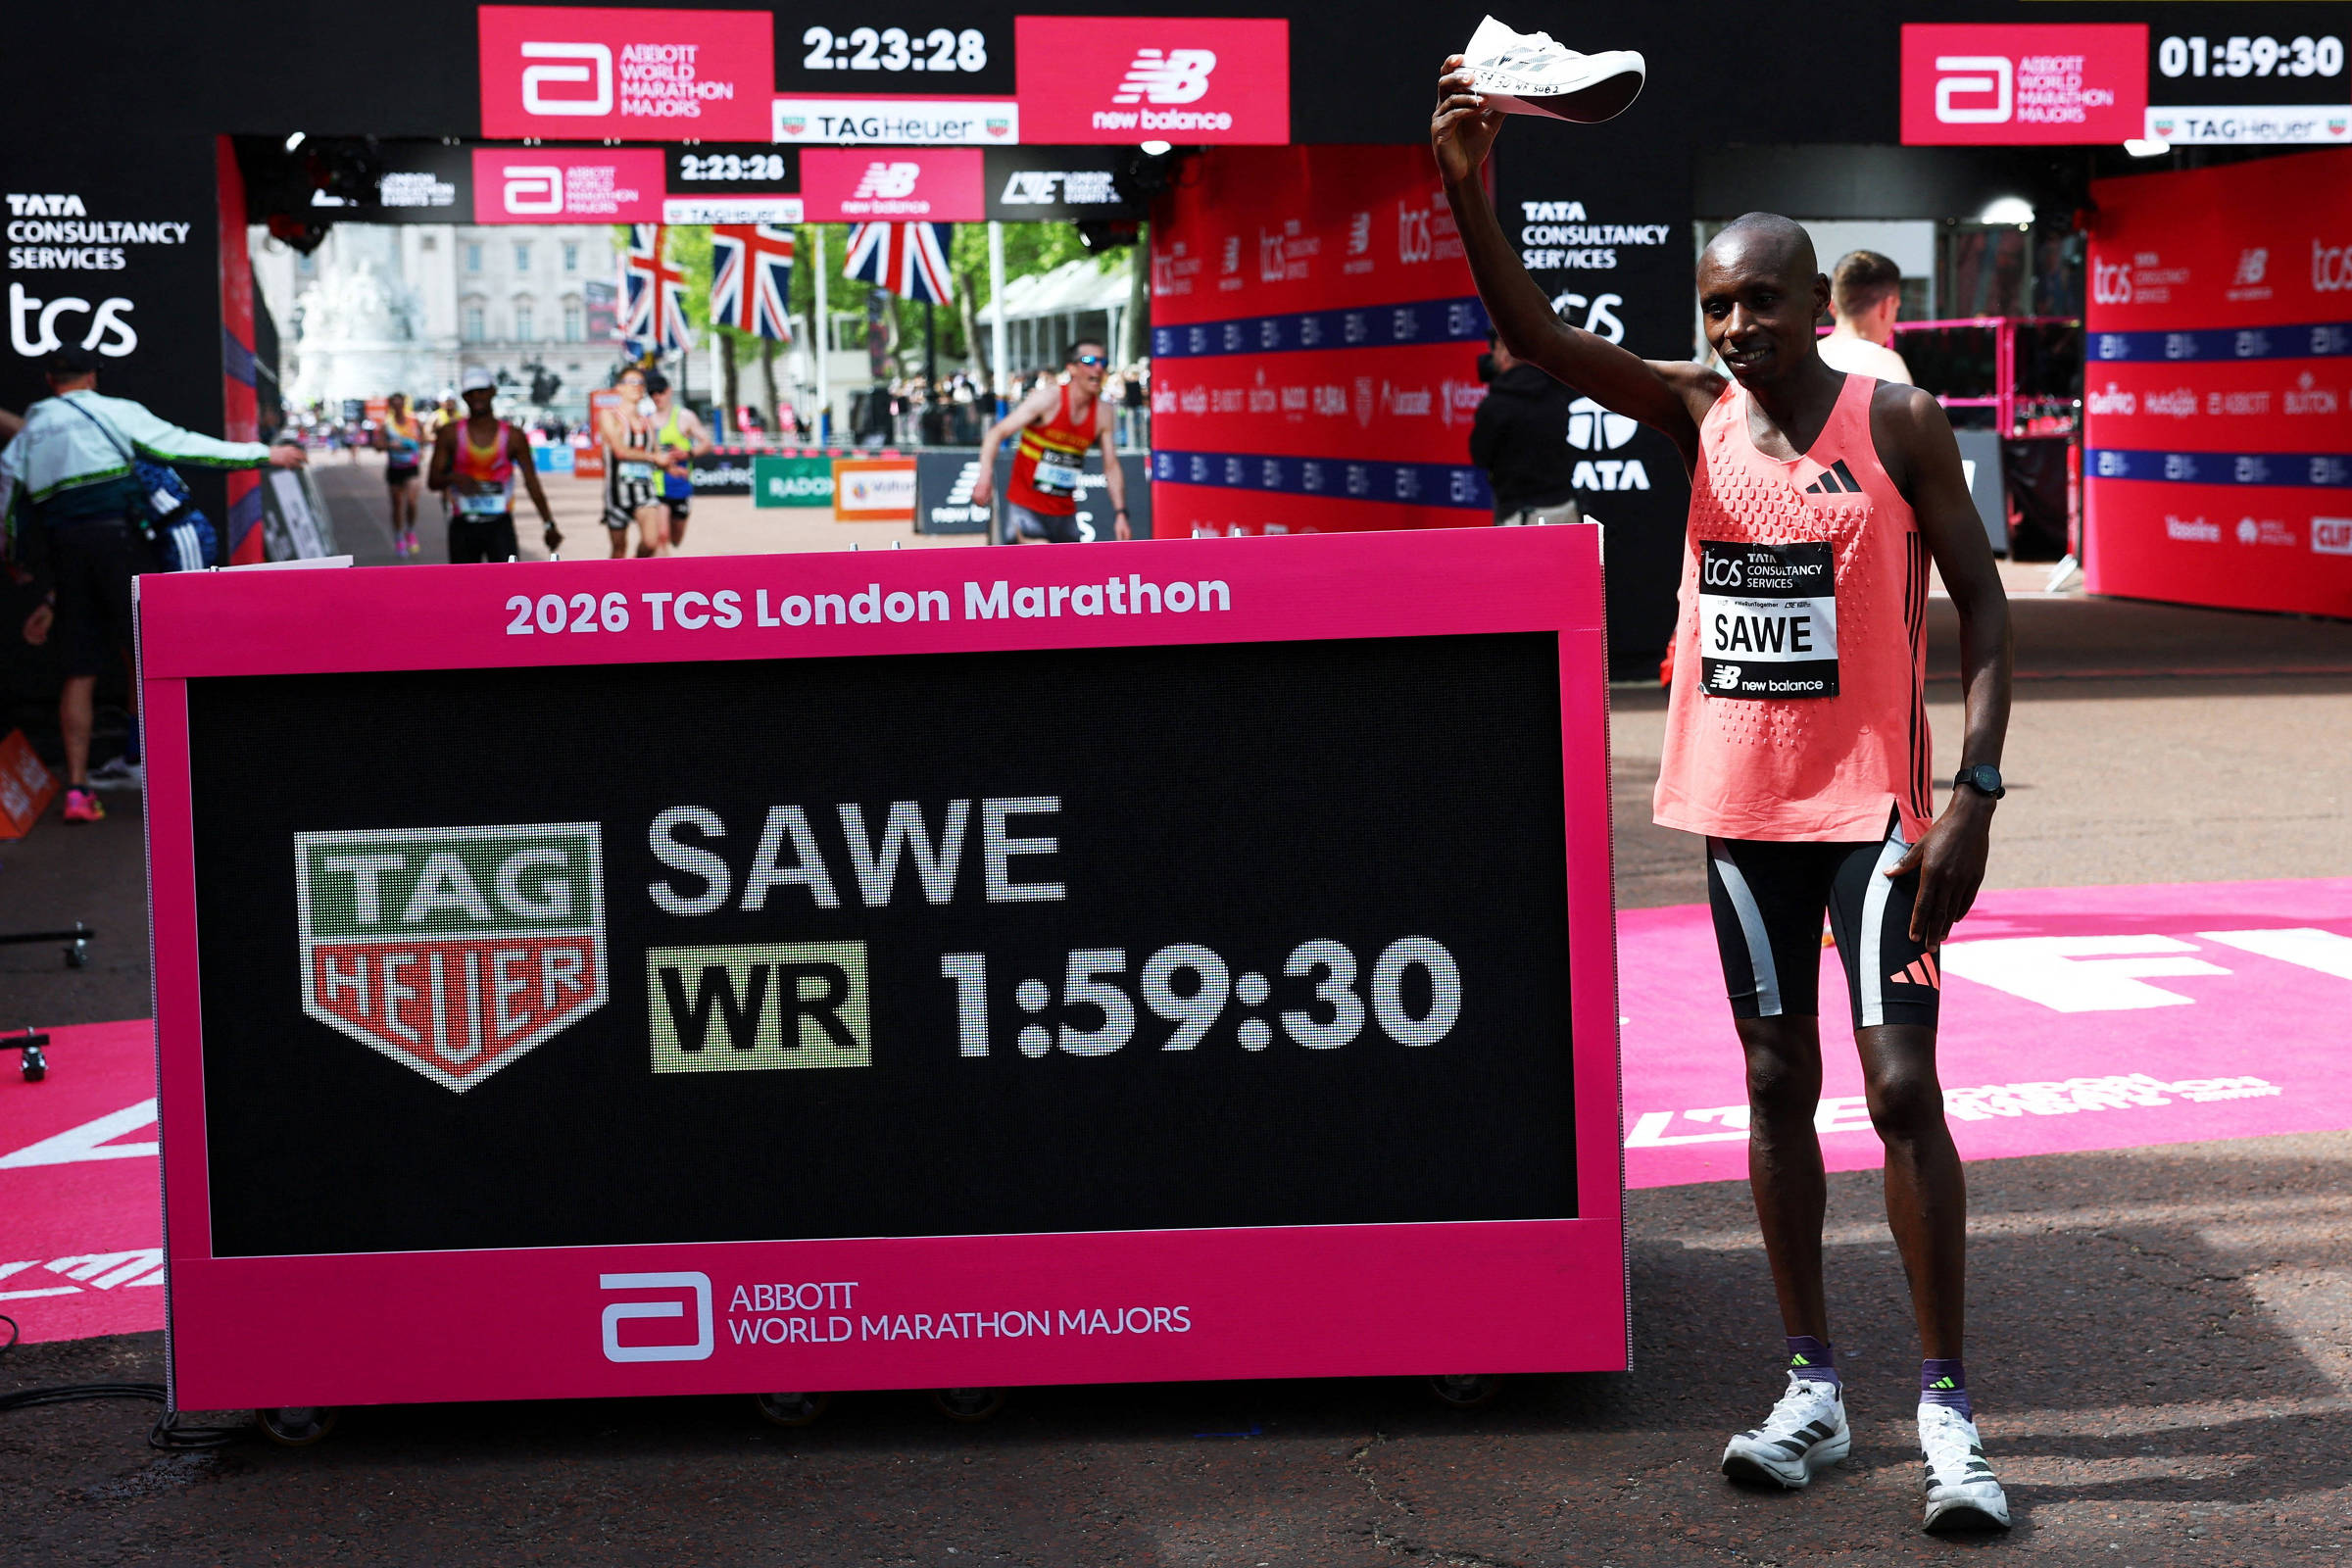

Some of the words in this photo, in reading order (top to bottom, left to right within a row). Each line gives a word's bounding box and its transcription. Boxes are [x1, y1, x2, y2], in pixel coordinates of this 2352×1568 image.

[619, 43, 699, 64] ABBOTT
[803, 26, 987, 73] 2:23:28
[2159, 35, 2344, 77] 01:59:30
[619, 63, 696, 82] WORLD
[2017, 55, 2085, 74] ABBOTT
[619, 80, 734, 100] MARATHON
[2017, 73, 2082, 90] WORLD
[620, 99, 702, 118] MAJORS
[2017, 88, 2115, 107] MARATHON
[1092, 111, 1138, 129] new
[1140, 108, 1233, 130] balance
[2017, 105, 2086, 122] MAJORS
[680, 154, 784, 180] 2:23:28
[6, 194, 87, 217] TATA
[1521, 201, 1587, 221] TATA
[7, 220, 191, 244] CONSULTANCY
[1521, 224, 1670, 245] CONSULTANCY
[9, 247, 126, 270] SERVICES
[2093, 255, 2132, 305] tcs
[9, 281, 138, 358] tcs
[1571, 460, 1651, 491] ATA
[1704, 550, 1743, 587] tcs
[1747, 553, 1777, 564] TATA
[1747, 564, 1823, 576] CONSULTANCY
[1747, 577, 1793, 589] SERVICES
[505, 592, 629, 635] 2026
[642, 590, 743, 630] TCS
[757, 583, 950, 627] London
[964, 573, 1231, 620] Marathon
[1715, 613, 1813, 654] SAWE
[1741, 681, 1766, 692] new
[1768, 679, 1824, 692] balance
[647, 796, 1067, 916] SAWE
[324, 849, 572, 925] TAG
[324, 947, 584, 1066] HEUER
[659, 961, 858, 1054] WR
[940, 934, 1463, 1058] 1:59:30
[728, 1282, 858, 1313] ABBOTT
[728, 1316, 853, 1345] WORLD
[862, 1310, 1051, 1342] MARATHON
[1059, 1305, 1191, 1336] MAJORS
